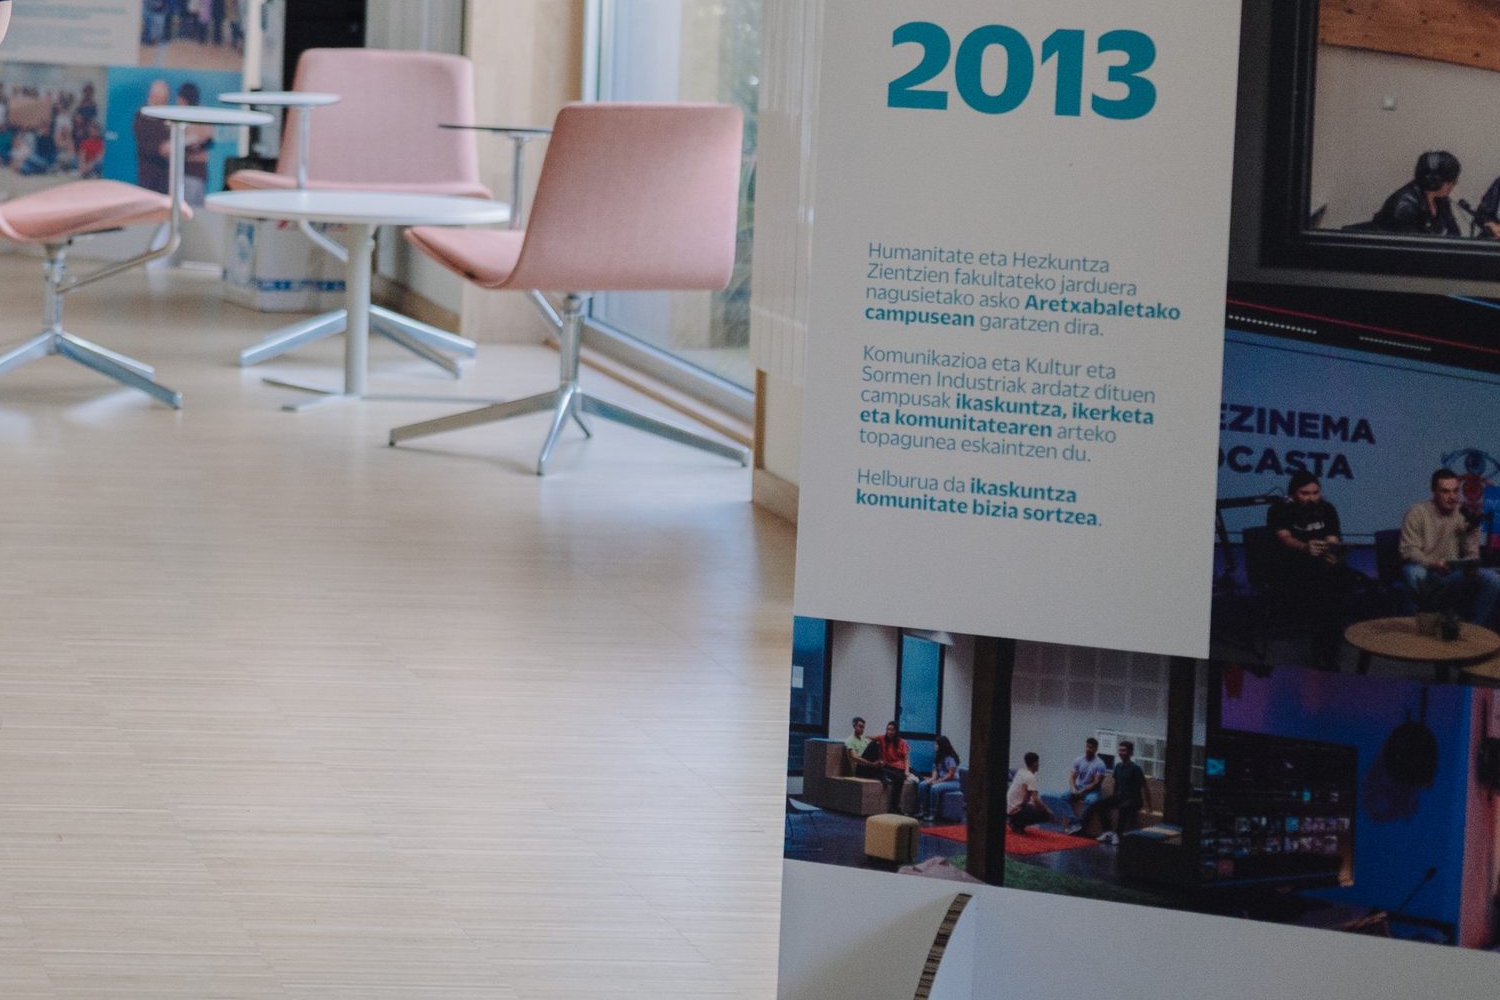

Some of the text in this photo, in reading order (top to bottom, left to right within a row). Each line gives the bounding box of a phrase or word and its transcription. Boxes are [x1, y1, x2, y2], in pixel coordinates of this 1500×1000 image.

[887, 21, 1157, 120] 2013
[868, 242, 1110, 274] Humanitate eta Hezkuntza
[866, 262, 1138, 297] Zientzien fakultateko jarduera
[865, 286, 1181, 321] nagusietako asko Aretxabaletako
[865, 306, 1104, 337] campusean garatzen dira.
[862, 345, 1116, 380] Komunikazioa eta Kultur eta
[861, 365, 1156, 404] Sormen Industriak ardatz dituen
[860, 389, 1155, 425] campusak ikaskuntza, ikerketa
[859, 408, 1117, 444] eta komunitatearen arteko
[858, 427, 1092, 462] topagunea eskaintzen du.
[1217, 445, 1355, 480] CASTA
[856, 468, 1078, 503] Helburua da ikaskuntza
[855, 488, 1103, 527] komunitate bizia sortzea.
